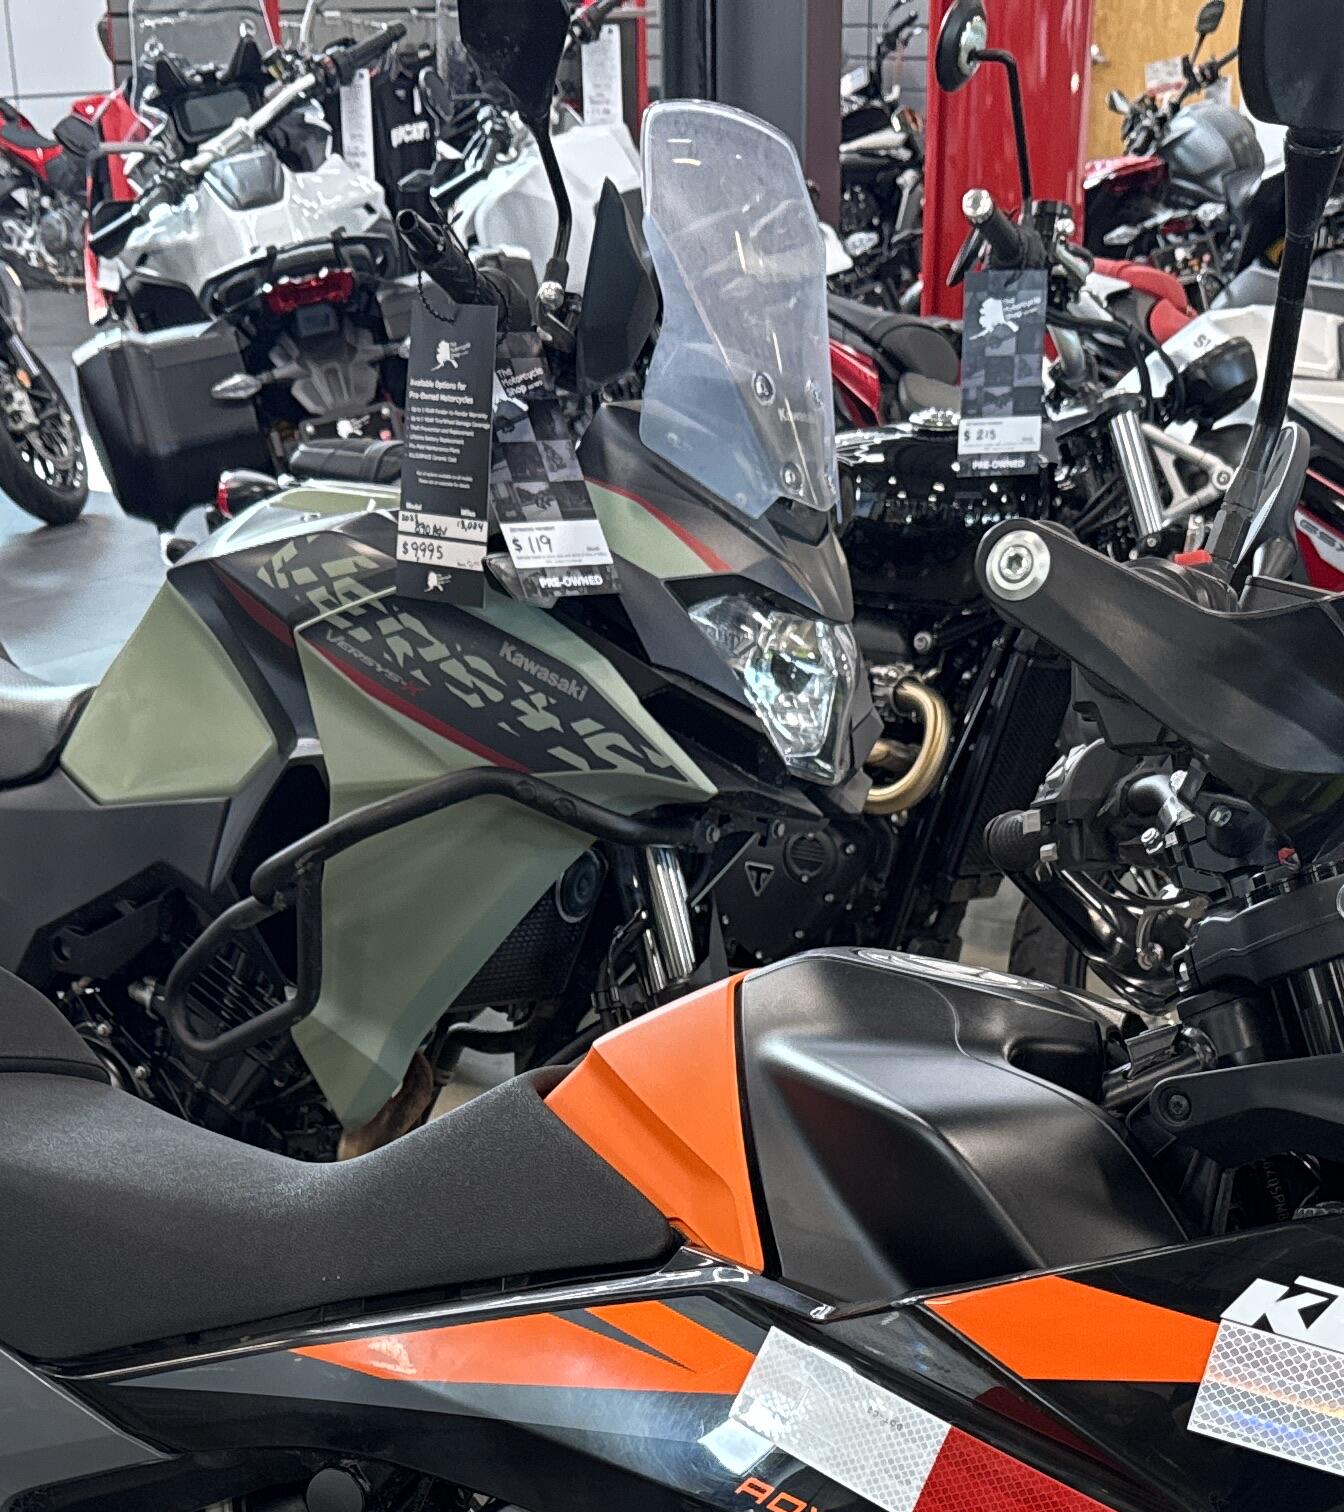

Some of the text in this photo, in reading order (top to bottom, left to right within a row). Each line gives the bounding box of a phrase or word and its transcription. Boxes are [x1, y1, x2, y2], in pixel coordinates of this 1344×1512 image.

[528, 534, 553, 554] 119
[538, 574, 604, 589] PRE-OWNED
[498, 641, 589, 701] Kawasaki
